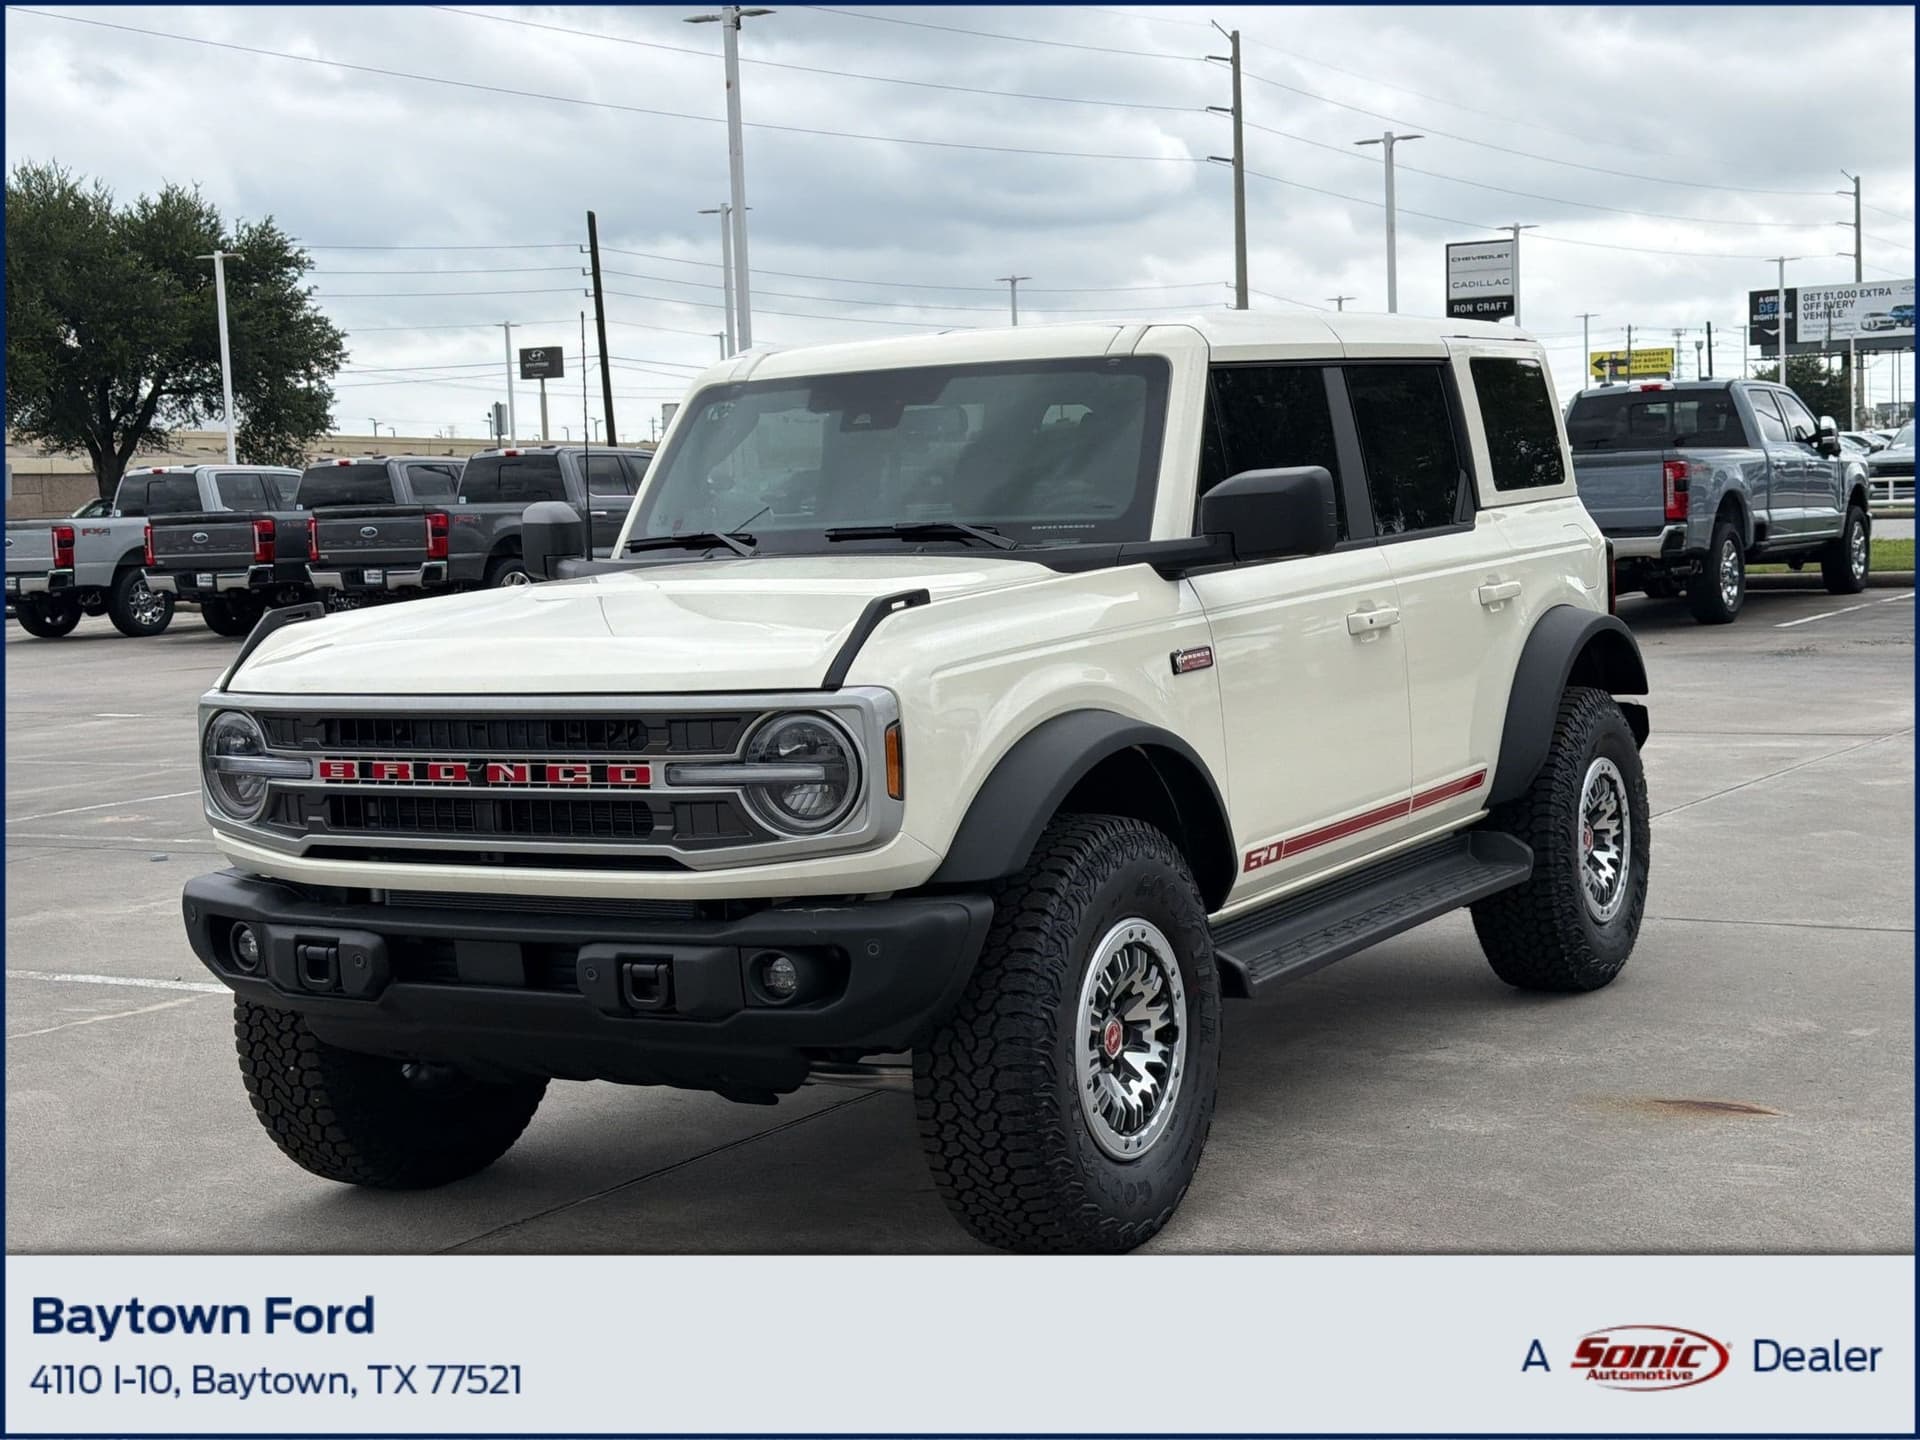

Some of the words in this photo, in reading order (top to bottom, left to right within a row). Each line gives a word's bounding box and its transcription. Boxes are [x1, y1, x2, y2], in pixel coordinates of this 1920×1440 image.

[1451, 253, 1510, 262] CHEVROLET
[1452, 278, 1510, 289] CADILLAC
[1803, 292, 1821, 302] GET
[1823, 290, 1857, 300] $1,000
[1859, 287, 1892, 298] EXTRA
[1453, 304, 1473, 313] RON
[1476, 301, 1508, 312] CRAFT
[1803, 301, 1821, 311] OFF
[1823, 299, 1856, 310] EVERY
[320, 760, 651, 785] BRONCO
